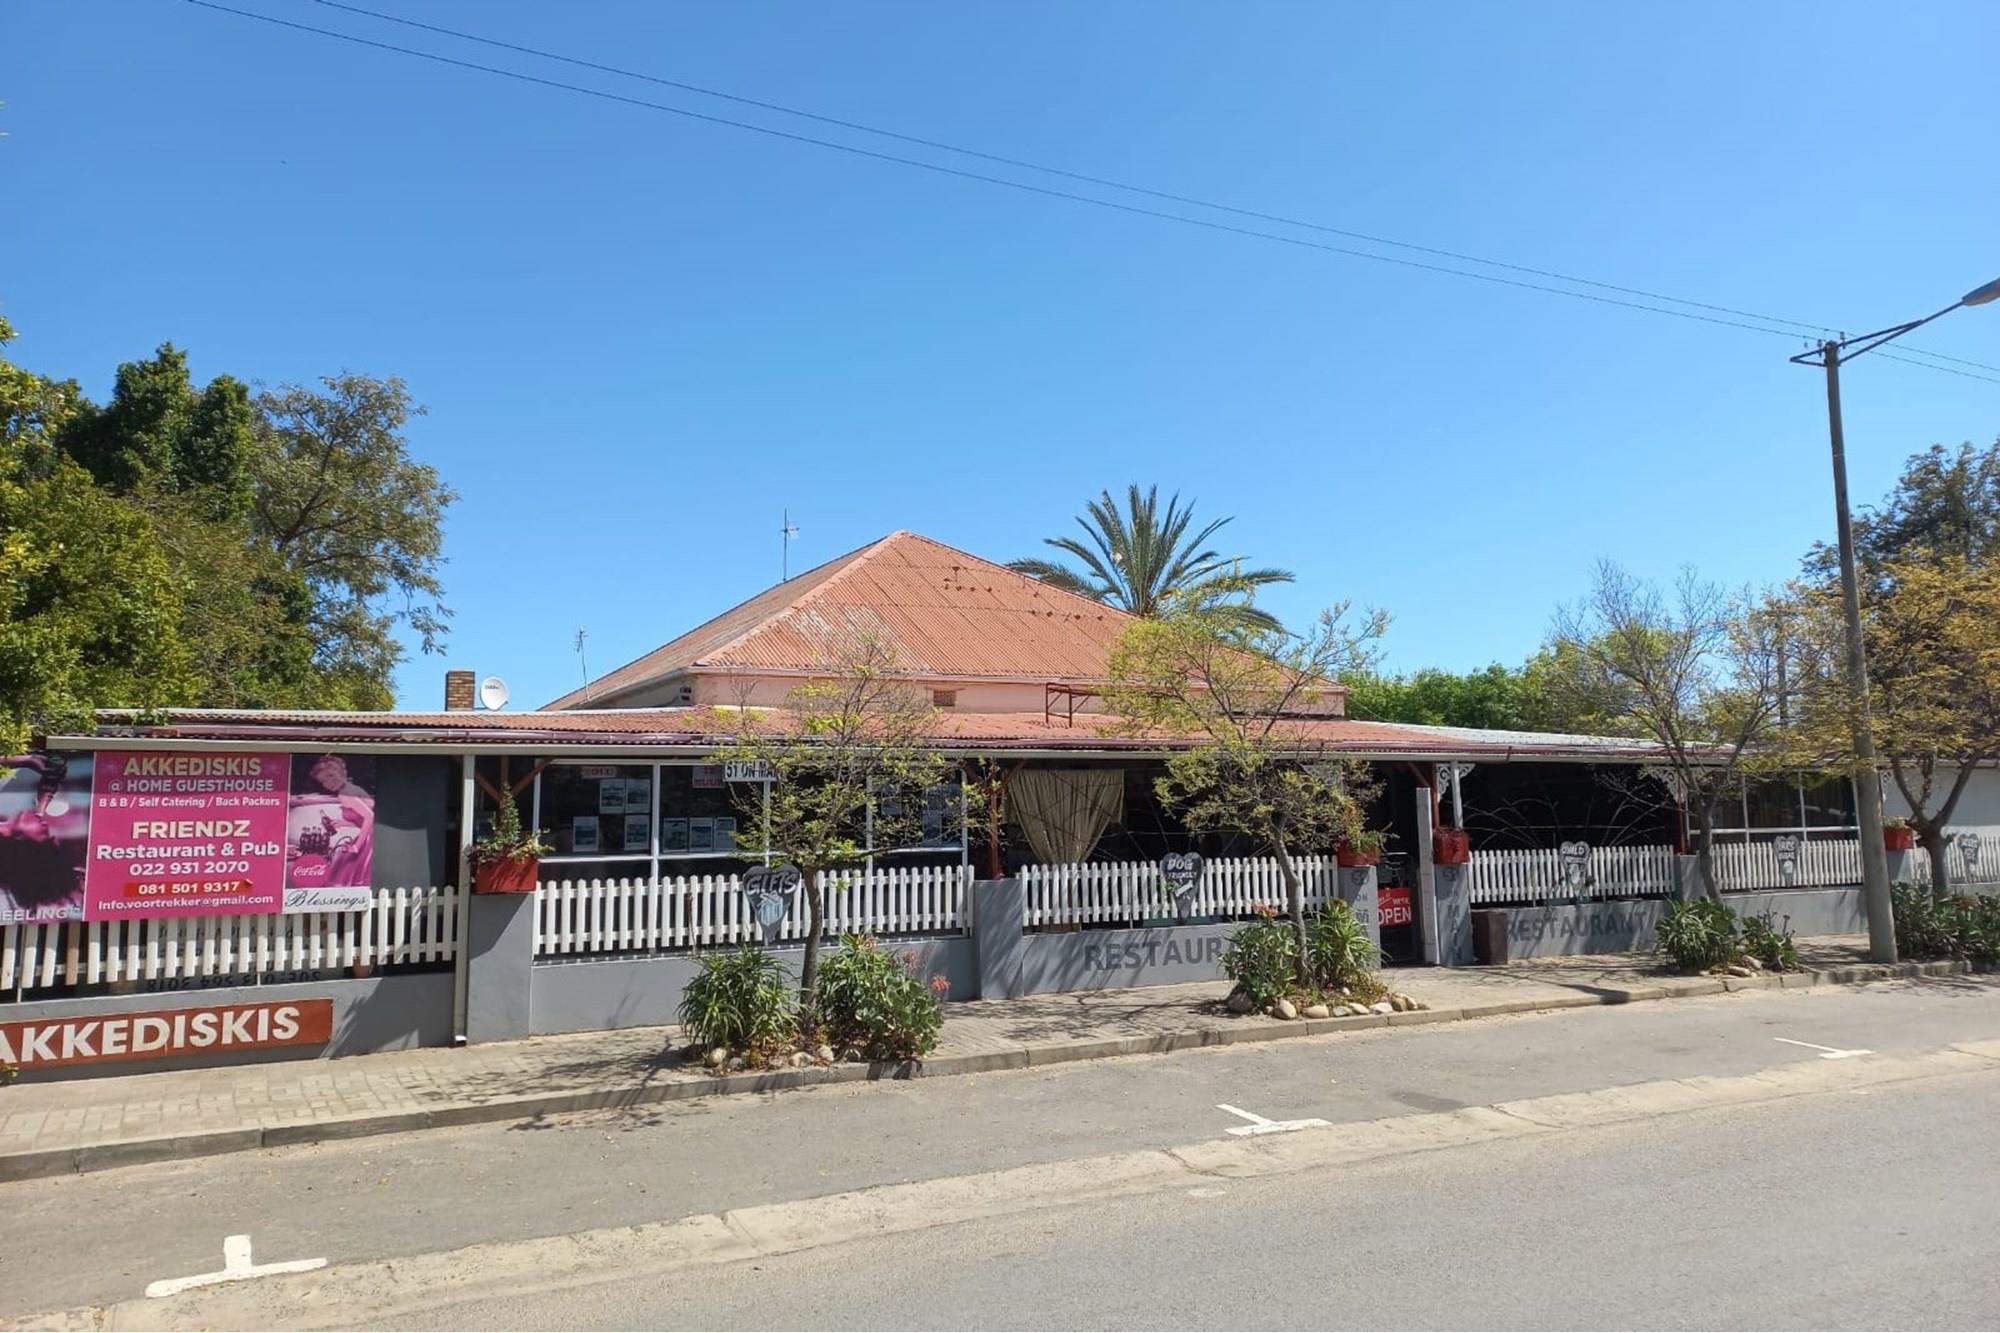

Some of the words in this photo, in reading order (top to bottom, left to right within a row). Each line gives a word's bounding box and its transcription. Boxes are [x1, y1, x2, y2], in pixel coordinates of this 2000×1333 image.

[123, 757, 262, 776] AKKEDISKIS
[108, 778, 123, 793] @
[127, 779, 172, 793] HOME
[175, 779, 274, 792] GUESTHOUSE
[99, 797, 109, 808] B
[109, 797, 118, 808] &
[119, 797, 128, 808] B
[138, 797, 160, 808] Self
[163, 796, 206, 809] Catering
[216, 796, 241, 807] Back
[244, 796, 281, 807] Packers
[132, 820, 251, 840] FRIENDZ
[96, 843, 216, 860] Restaurant
[221, 842, 235, 856] &
[241, 841, 281, 856] Pub
[129, 863, 165, 876] 022
[170, 861, 199, 875] 931
[204, 861, 250, 874] 2070
[1167, 858, 1194, 871] DOG
[138, 883, 167, 895] 081
[171, 882, 199, 895] 501
[203, 881, 241, 893] 9317
[746, 871, 797, 895] GIFTS
[0, 905, 69, 921] EELING
[1377, 906, 1412, 925] OPEN
[1083, 937, 1236, 972] RESTAUR
